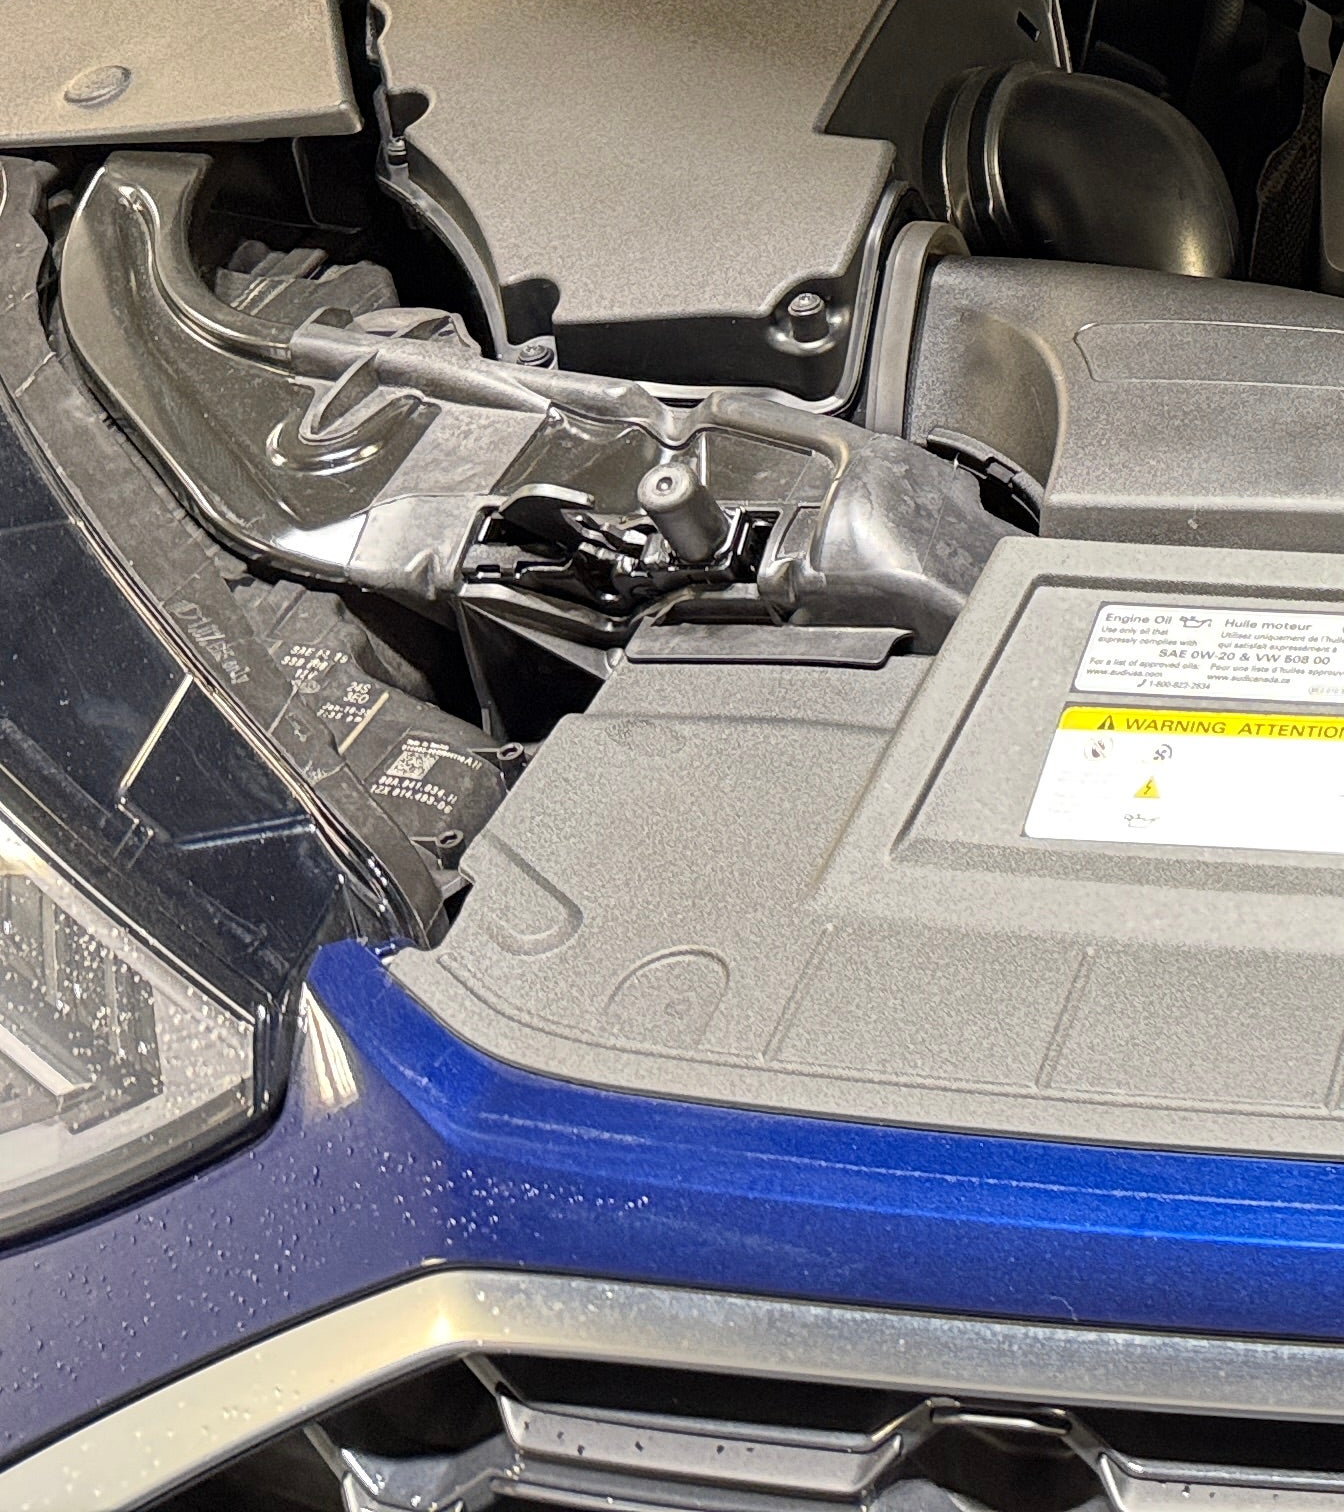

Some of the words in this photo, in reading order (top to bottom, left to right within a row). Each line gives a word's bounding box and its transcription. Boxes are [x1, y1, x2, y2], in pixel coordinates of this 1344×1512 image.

[1105, 613, 1150, 625] Engine
[1154, 615, 1172, 625] Oil
[1225, 619, 1257, 629] Huile
[1262, 621, 1312, 631] moteur
[1119, 627, 1136, 636] only
[1152, 628, 1169, 636] that
[1221, 632, 1252, 640] Utilisez
[1254, 634, 1305, 642] uniquement
[1098, 637, 1136, 645] expressly
[1139, 638, 1177, 646] complies
[1218, 642, 1231, 650] qui
[1234, 642, 1267, 650] satisfait
[1089, 657, 1103, 665] For
[1113, 659, 1126, 667] list
[1139, 661, 1181, 669] approved
[1158, 649, 1188, 659] SAE
[1191, 650, 1235, 661] 0W-20
[1239, 652, 1250, 661] &
[1256, 653, 1281, 662] VW
[1284, 654, 1309, 664] 508
[1313, 656, 1331, 665] 00
[1210, 663, 1230, 671] Pour
[1251, 665, 1269, 673] liste
[346, 681, 372, 694] 24S
[1125, 717, 1227, 735] WARNING
